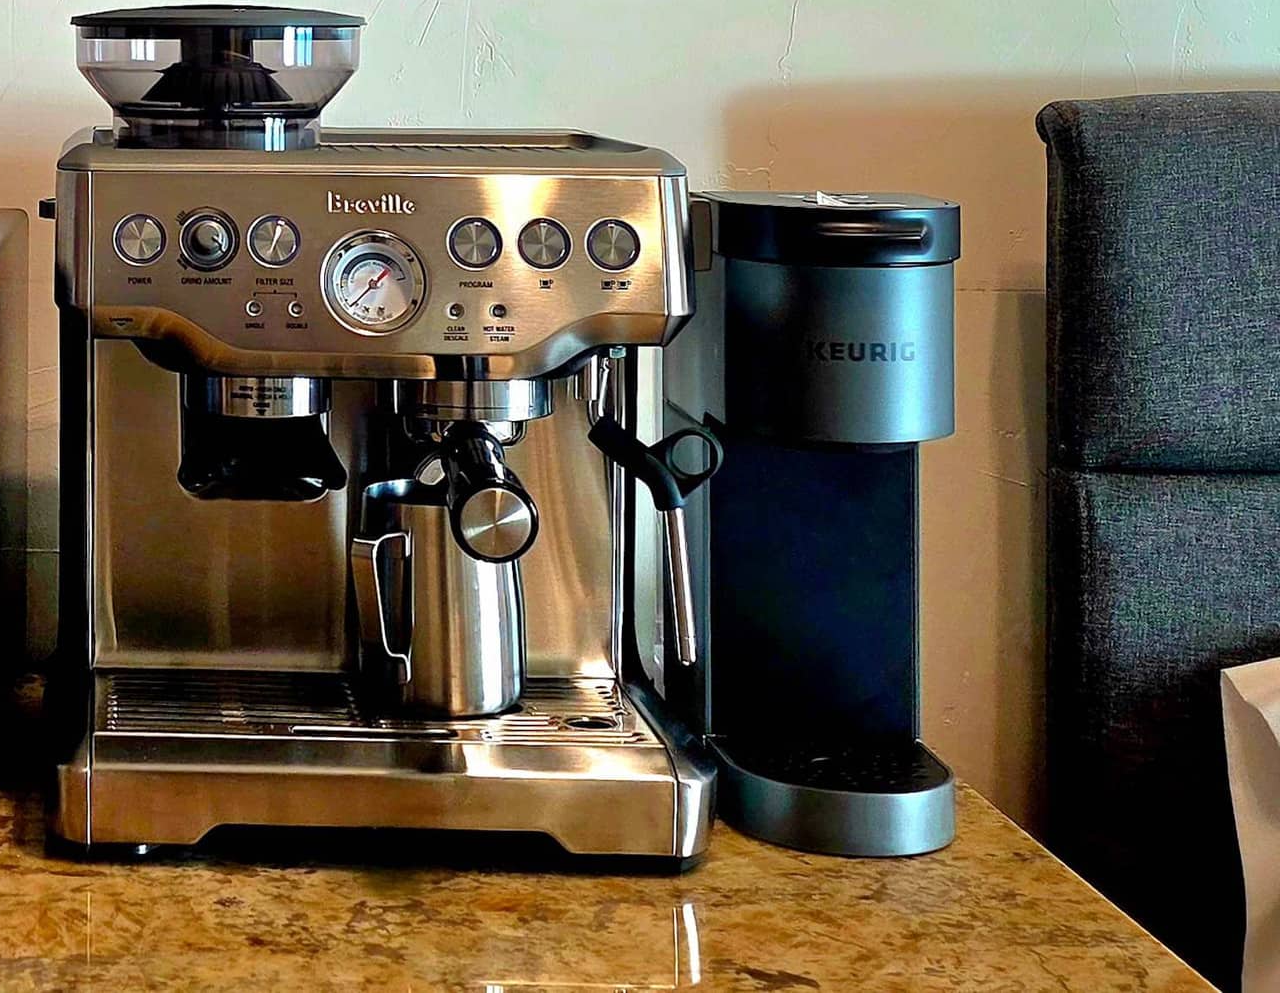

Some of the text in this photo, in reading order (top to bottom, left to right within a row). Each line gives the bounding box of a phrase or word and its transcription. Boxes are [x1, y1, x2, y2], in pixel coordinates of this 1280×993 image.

[326, 190, 417, 215] Breville
[127, 277, 153, 286] POWER
[180, 277, 233, 286] GRIND AMOUNT
[255, 278, 294, 287] FILTER SIZE
[458, 280, 494, 289] PROGRAM
[807, 341, 916, 363] KEURIG
